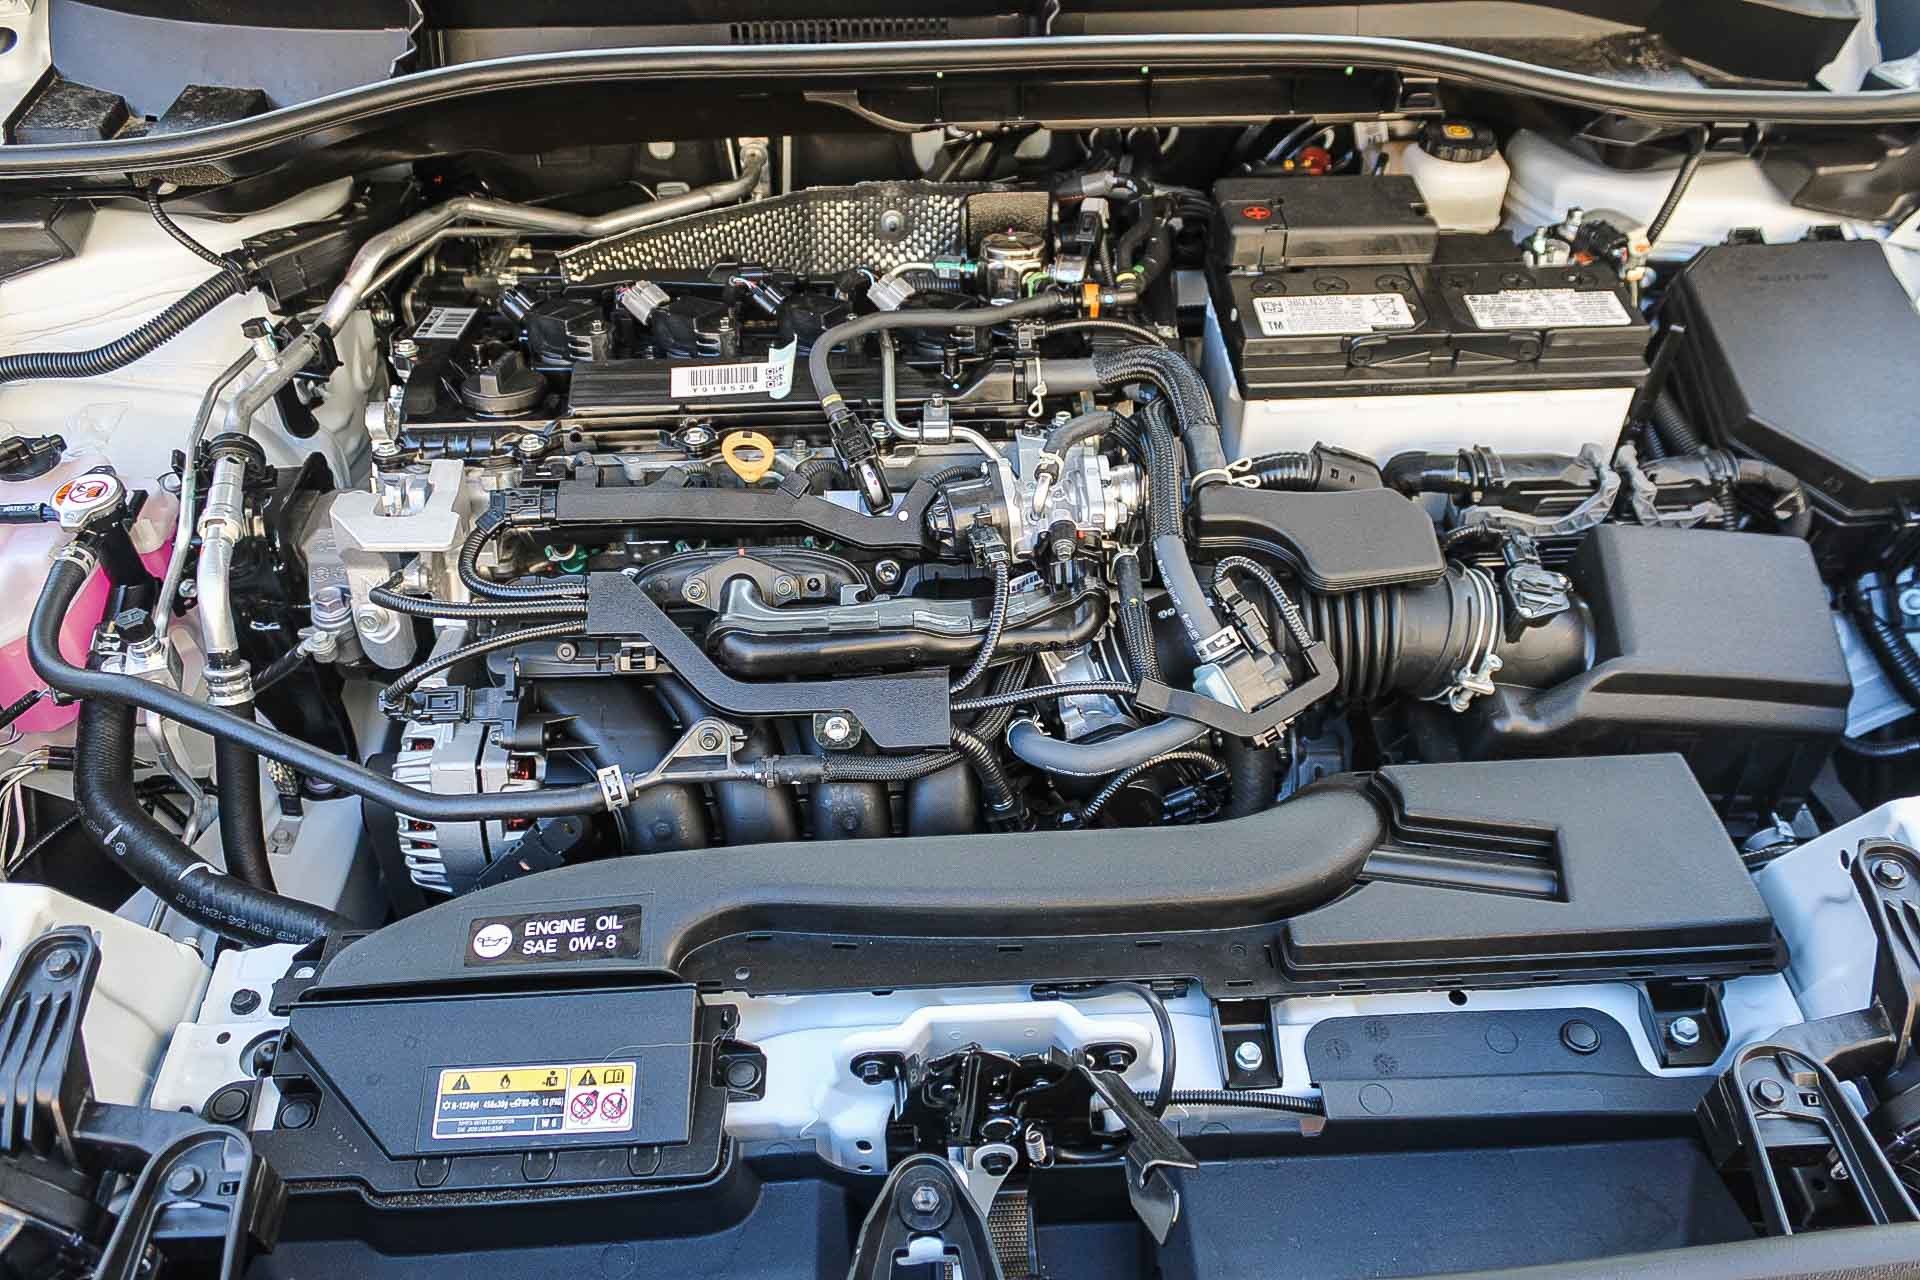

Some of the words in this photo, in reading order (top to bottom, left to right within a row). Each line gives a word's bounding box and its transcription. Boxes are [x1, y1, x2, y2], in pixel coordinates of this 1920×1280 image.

[524, 917, 586, 937] ENGINE
[595, 914, 624, 931] OIL
[522, 938, 558, 955] SAE
[568, 934, 617, 952] 0W-8
